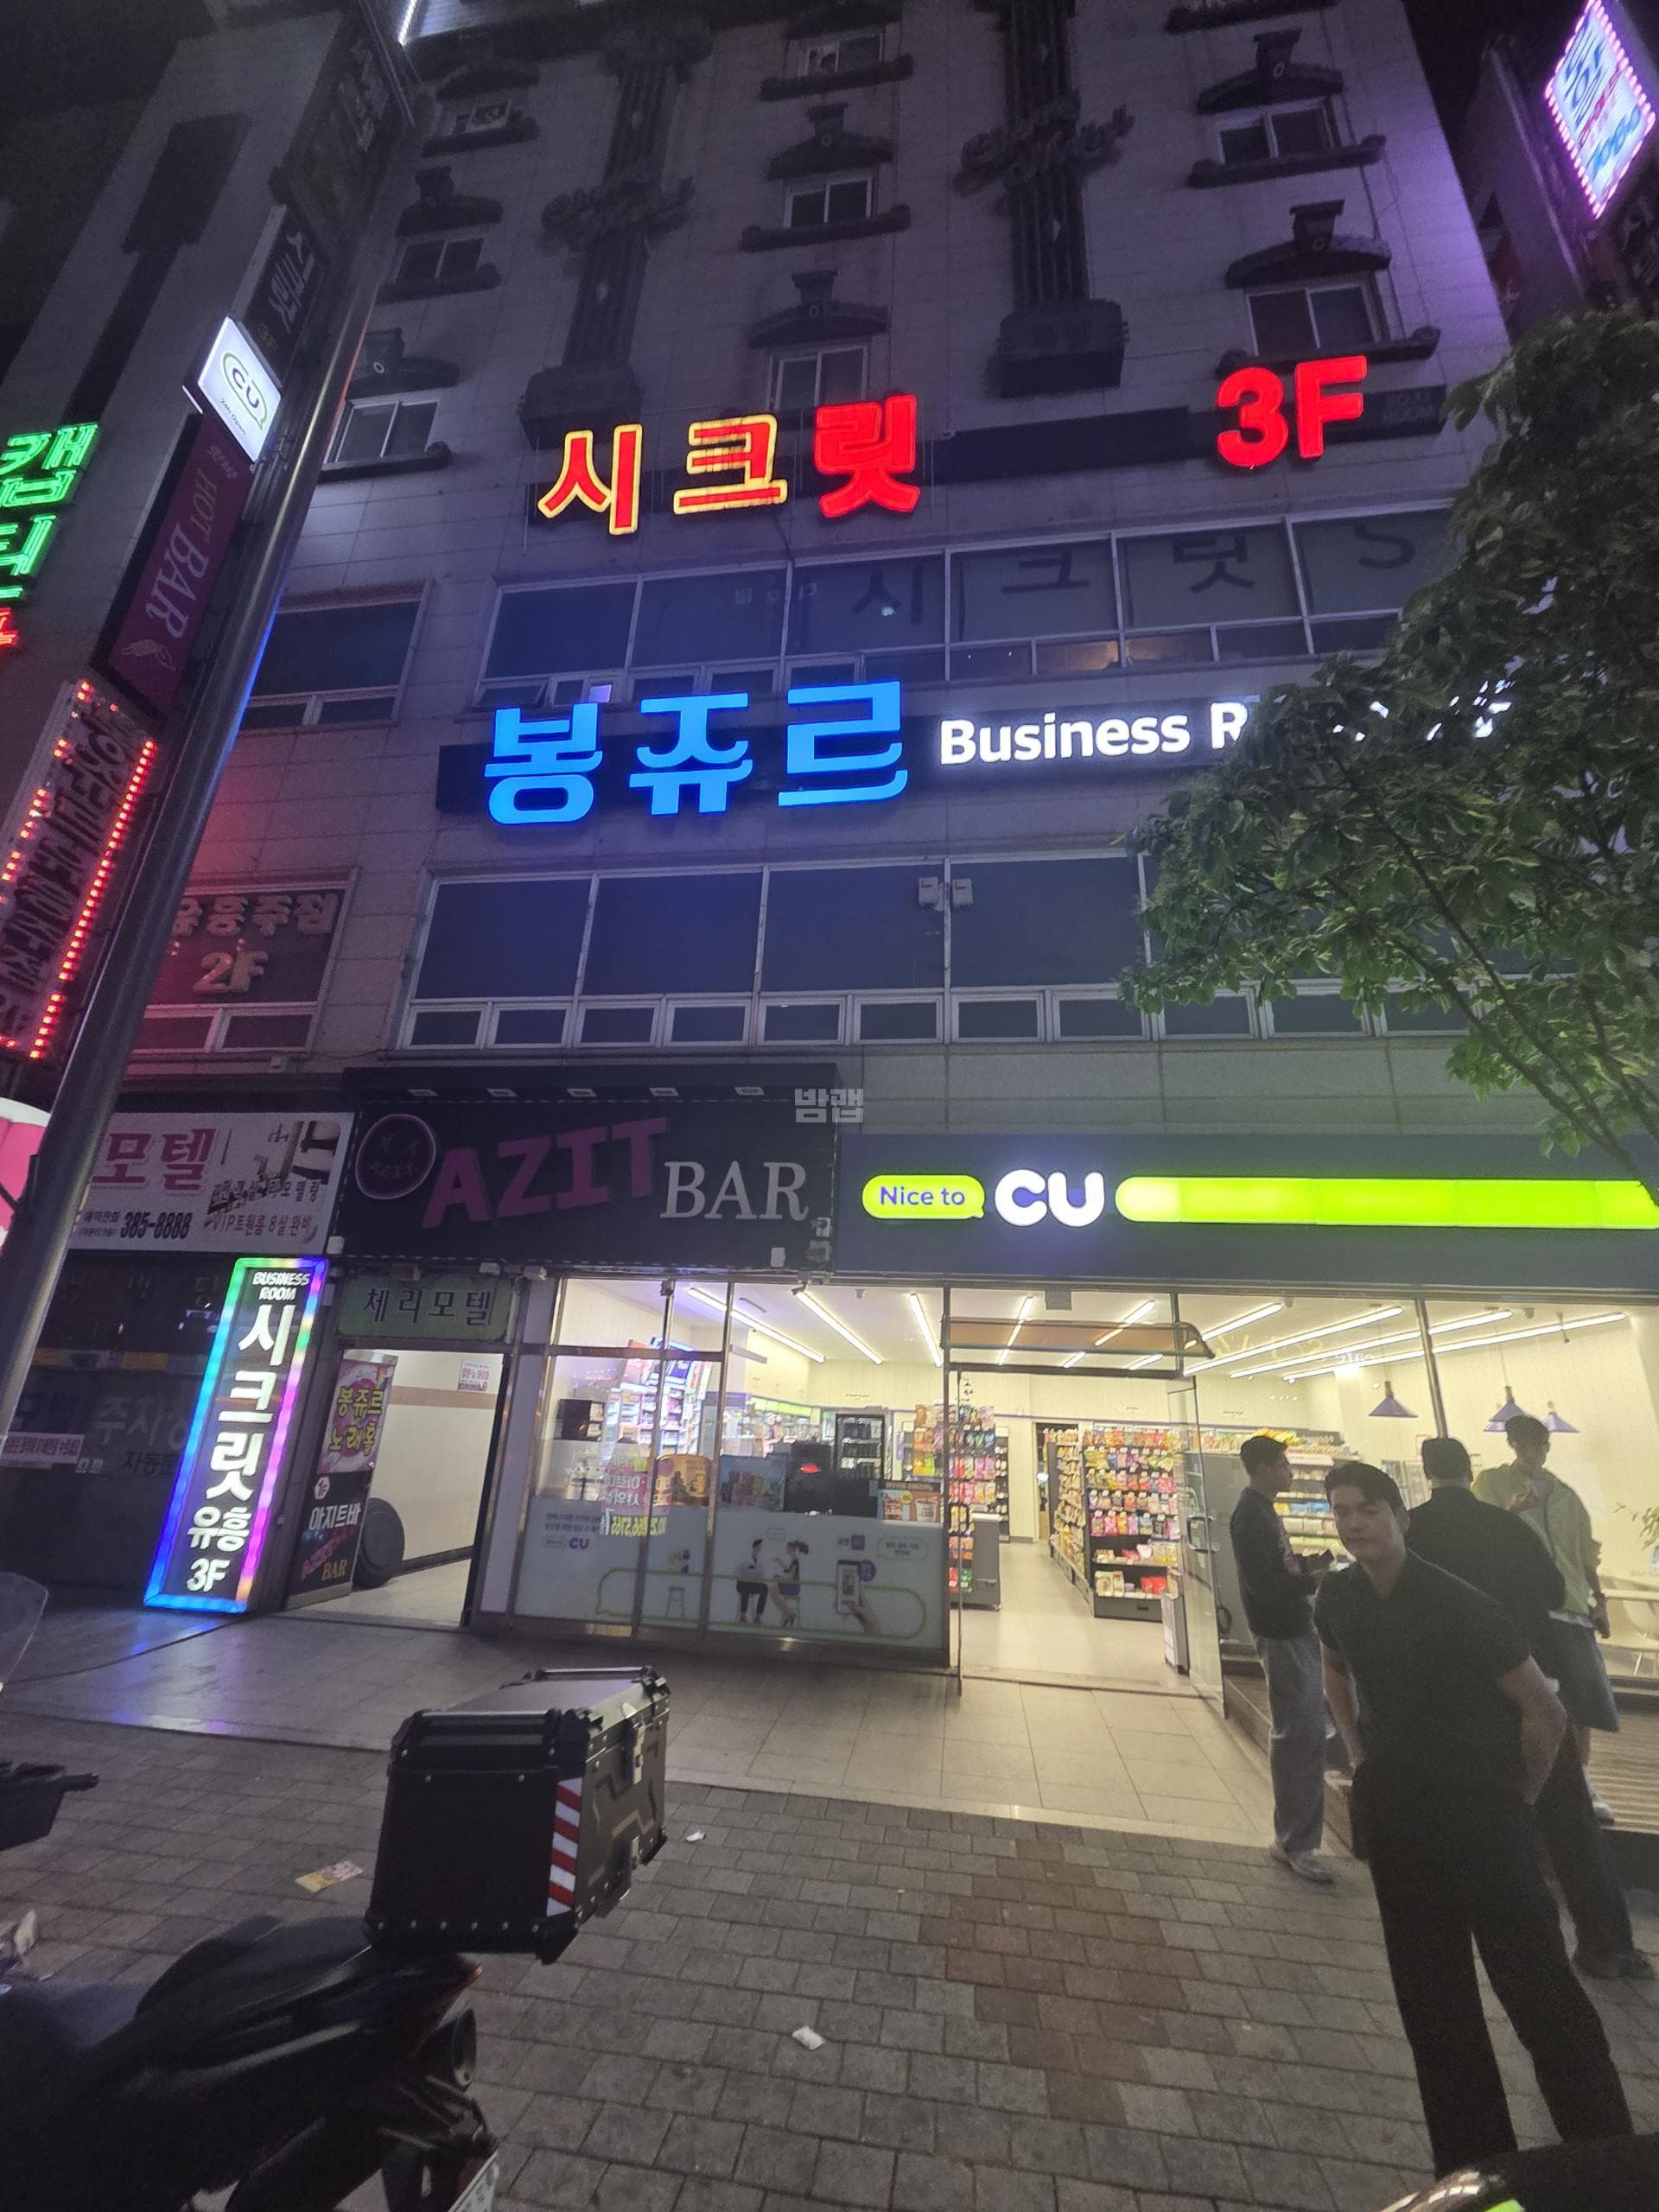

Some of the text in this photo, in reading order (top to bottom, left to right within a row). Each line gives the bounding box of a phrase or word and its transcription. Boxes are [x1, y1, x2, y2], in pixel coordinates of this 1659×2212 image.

[231, 368, 260, 410] CU
[537, 355, 1368, 536] 시크릿 3F
[145, 467, 217, 639] HOT BAR
[483, 679, 908, 825] 봉쥬르
[939, 711, 1191, 766] Business
[194, 951, 269, 994] 2F
[92, 1128, 216, 1191] 모텔
[421, 1116, 809, 1229] AZIT BAR
[880, 1168, 1106, 1228] Nice to CU
[120, 1211, 193, 1240] 385-8888
[252, 1271, 311, 1286] BUSINESS
[259, 1287, 296, 1301] ROOM
[363, 1287, 492, 1326] 체리모텔
[205, 1304, 293, 1502] 시크릿
[337, 1386, 385, 1419] 봉쥬르
[329, 1423, 378, 1457] 노래홀
[187, 1506, 251, 1553] 유흥
[308, 1503, 361, 1532] 아지트바
[569, 1537, 589, 1549] CU
[186, 1557, 230, 1593] 3F
[321, 1559, 347, 1580] BAR
